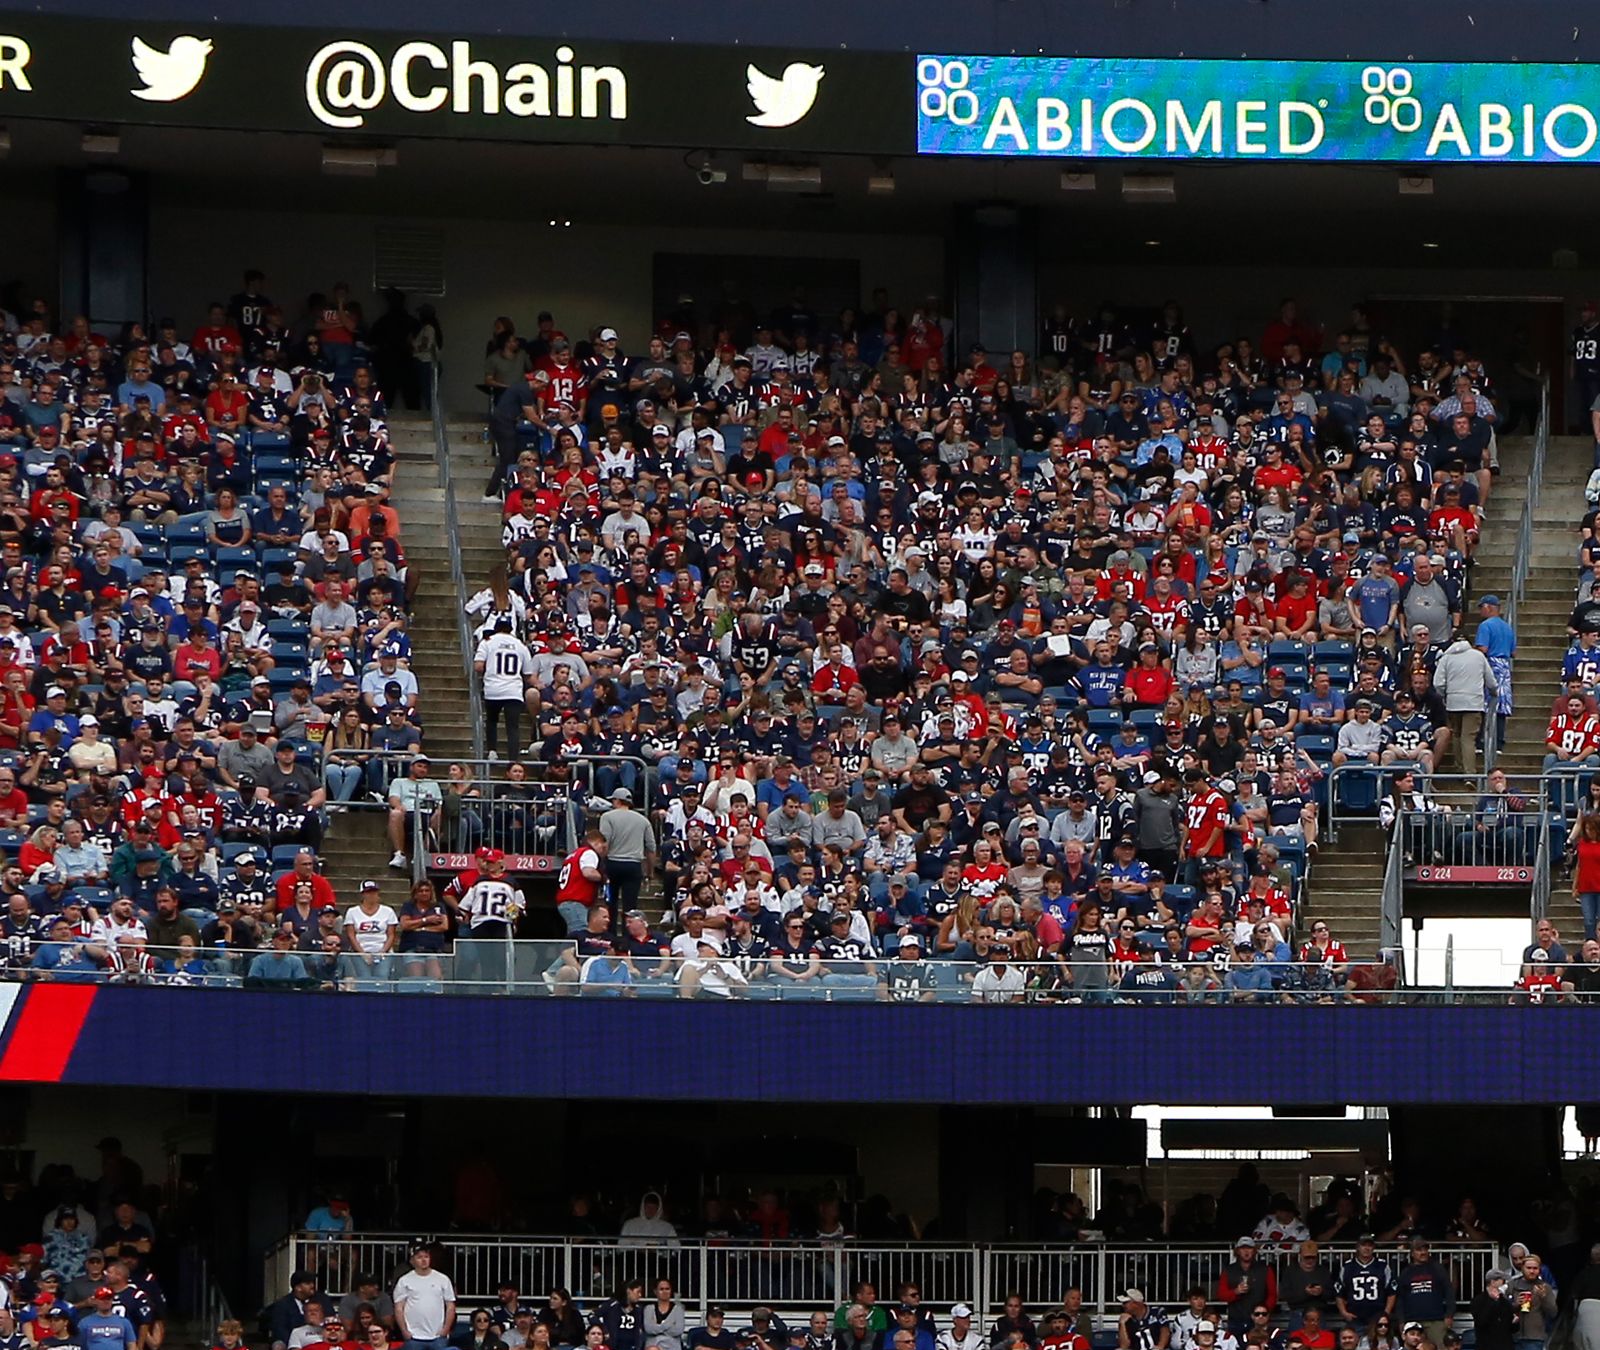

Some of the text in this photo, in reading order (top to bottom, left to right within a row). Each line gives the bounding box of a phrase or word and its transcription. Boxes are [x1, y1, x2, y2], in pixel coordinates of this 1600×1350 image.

[306, 41, 626, 127] @Chain
[1576, 340, 1597, 359] 83
[553, 379, 573, 401] 12
[496, 653, 518, 675] 10
[742, 648, 768, 668] 53
[1577, 661, 1599, 685] 16
[1561, 730, 1584, 754] 87
[451, 855, 467, 866] 223
[517, 858, 533, 869] 224
[1435, 868, 1450, 879] 224
[1498, 869, 1514, 879] 225
[1353, 1277, 1378, 1300] 53
[1136, 1329, 1153, 1350] 11
